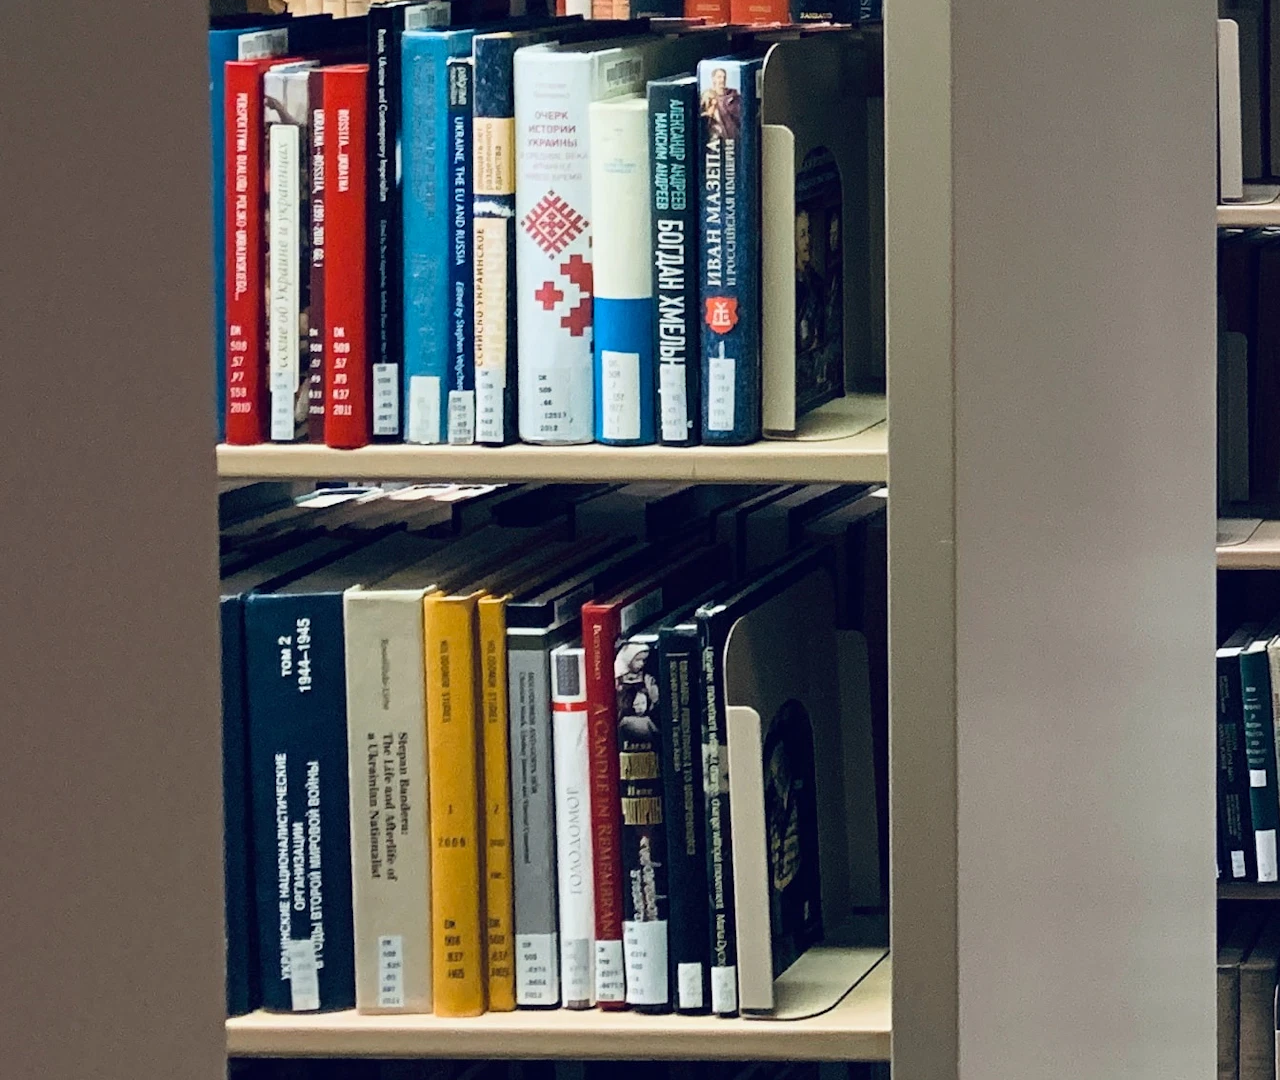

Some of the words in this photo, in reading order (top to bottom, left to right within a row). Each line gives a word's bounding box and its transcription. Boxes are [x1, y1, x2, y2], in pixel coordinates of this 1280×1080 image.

[454, 117, 465, 164] UKRAINE,
[528, 124, 576, 135] ИСТОРИИ
[528, 137, 577, 149] УКРАИНЫ
[655, 113, 667, 160] МАКСИМ
[669, 99, 685, 161] АЛЕКСАНДР
[455, 166, 465, 185] THE
[455, 188, 464, 202] EU
[655, 163, 669, 210] АНДРЕЕВ
[670, 163, 686, 210] АНДРЕЕВ
[705, 139, 722, 223] МАЗЕПА
[455, 204, 465, 227] AND
[455, 229, 466, 265] RUSSIA
[655, 220, 685, 290] БОГДАН
[707, 229, 722, 287] ИВАН
[278, 636, 291, 646] 2
[281, 648, 292, 677] ТОМ
[383, 733, 394, 756] The
[397, 732, 408, 775] Stepan
[306, 760, 320, 811] ВОЙНЫ
[368, 744, 379, 808] Ukrainian
[384, 760, 395, 783] Life
[385, 786, 396, 810] and
[400, 778, 411, 835] Bandera:
[306, 812, 321, 869] МИРОВОЙ
[369, 811, 382, 879] Nationalist
[386, 814, 397, 866] Afterlife
[292, 822, 305, 911] ОРГАНИЗАЦИИ
[387, 870, 398, 882] of
[308, 872, 323, 921] ВТОРОЙ
